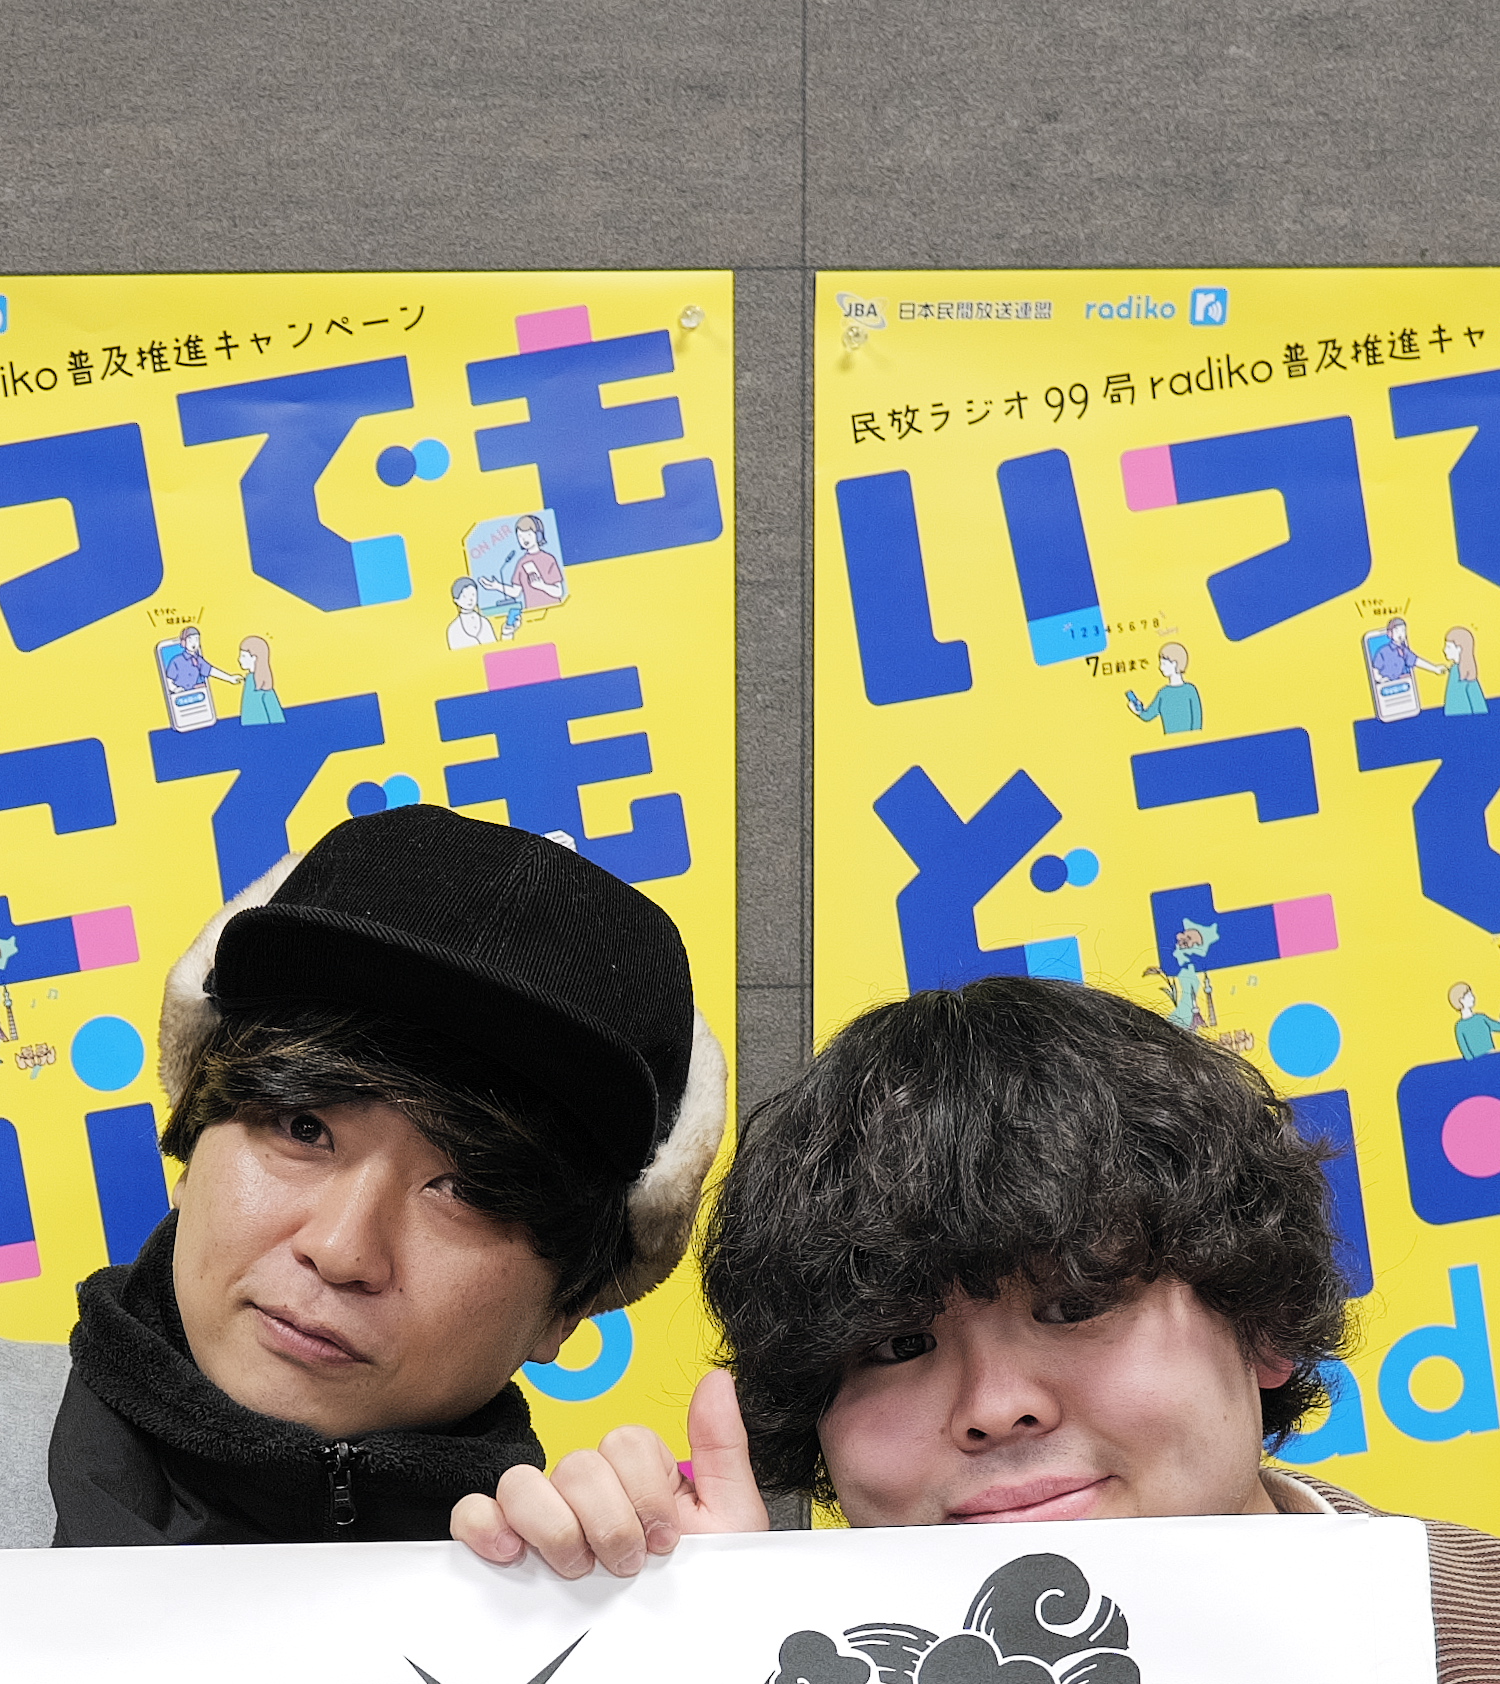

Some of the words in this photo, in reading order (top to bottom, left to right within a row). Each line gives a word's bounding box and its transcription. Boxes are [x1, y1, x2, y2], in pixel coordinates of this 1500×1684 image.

[842, 302, 878, 319] JBA
[898, 301, 1052, 321] 日本民間放送連盟
[1085, 296, 1177, 321] radiko
